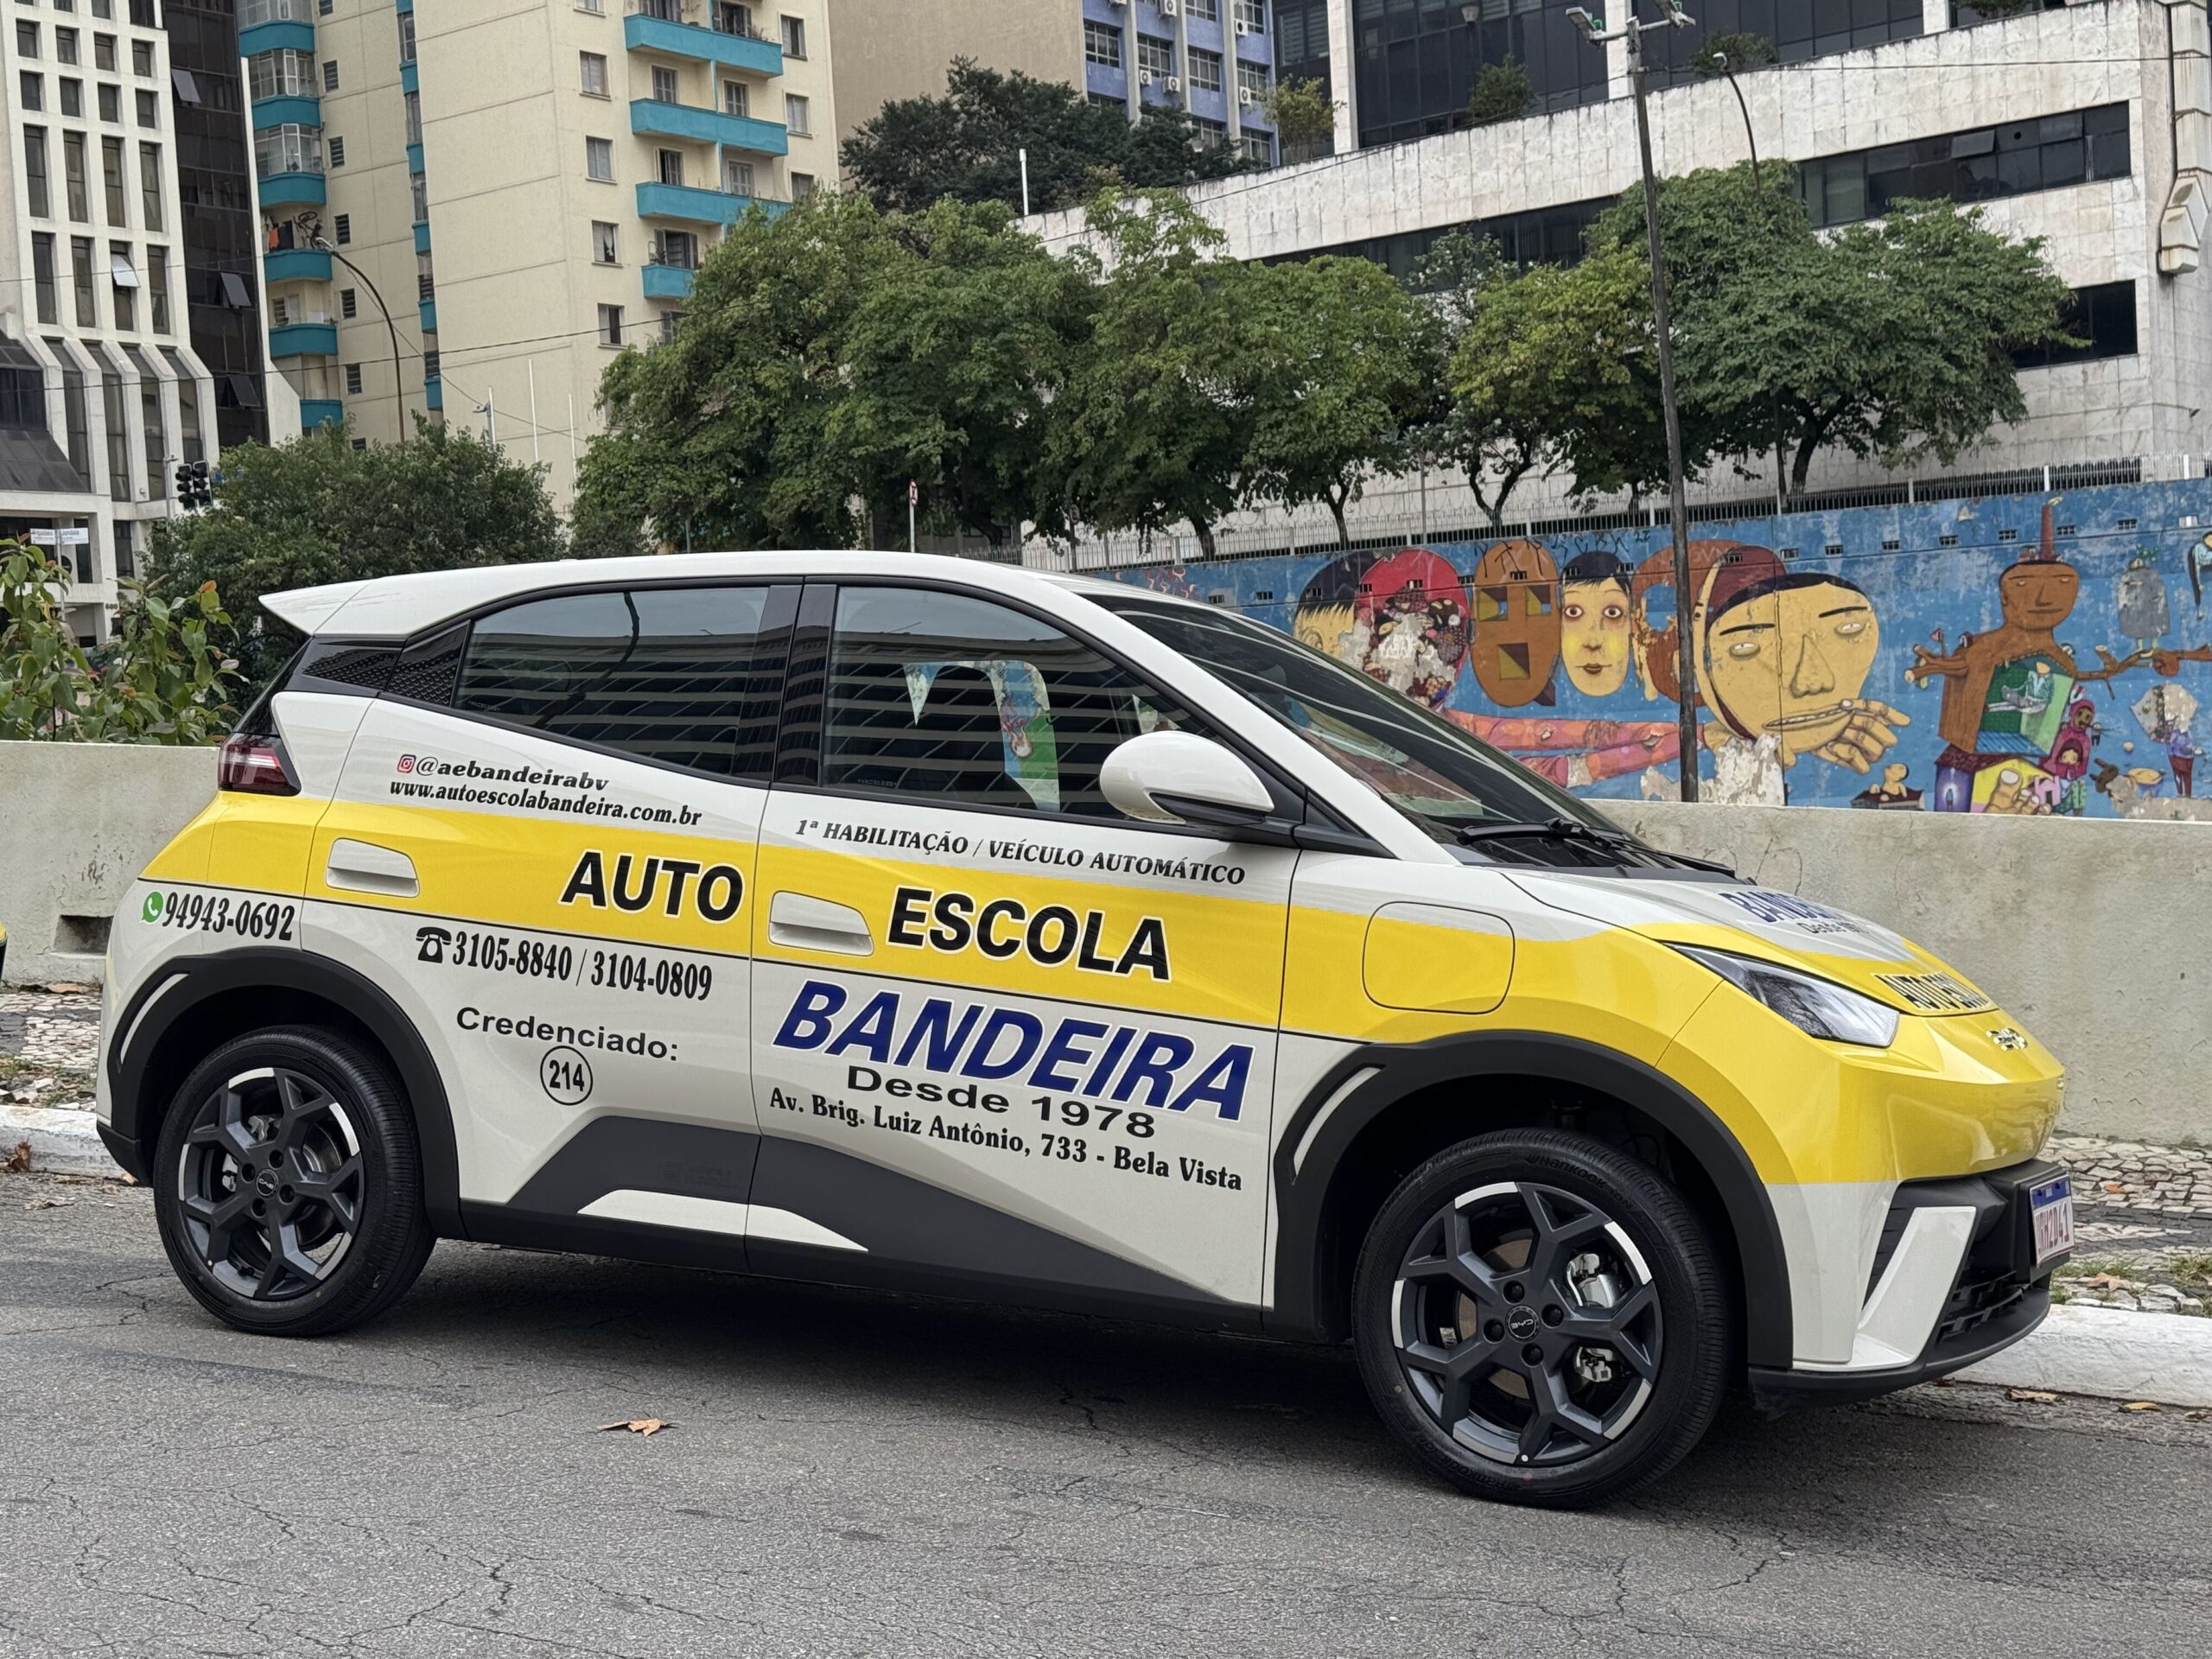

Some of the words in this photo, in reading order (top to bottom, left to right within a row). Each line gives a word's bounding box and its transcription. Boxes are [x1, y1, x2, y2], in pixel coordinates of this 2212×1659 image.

[390, 780, 702, 826] www.autoescolabandeira.com.br
[416, 756, 609, 791] @aebandeirabv
[562, 851, 743, 922] AUTO
[823, 823, 969, 855] HABILITAÇÃO
[972, 839, 984, 857] /
[988, 839, 1084, 867] VEÍCULO
[1090, 853, 1246, 885] AUTOMÁTICO
[162, 892, 296, 942] 94943-0692
[888, 887, 1171, 981] ESCOLA
[452, 931, 573, 981] 3105-8840
[575, 948, 588, 987] /
[590, 950, 713, 1001] 3104-0809
[456, 1007, 678, 1062] Credenciado:
[772, 979, 1255, 1122] BANDEIRA
[549, 1059, 585, 1092] 214
[847, 1065, 1010, 1114] Desde
[1031, 1096, 1155, 1139] 1978
[769, 1086, 804, 1113] Av.
[811, 1094, 866, 1128] Brig.
[874, 1105, 922, 1135] Luiz
[928, 1115, 1031, 1157] Antônio,
[1040, 1133, 1087, 1163] 733
[1096, 1154, 1105, 1162] -
[1113, 1145, 1170, 1178] Bela
[1179, 1156, 1243, 1191] Vista
